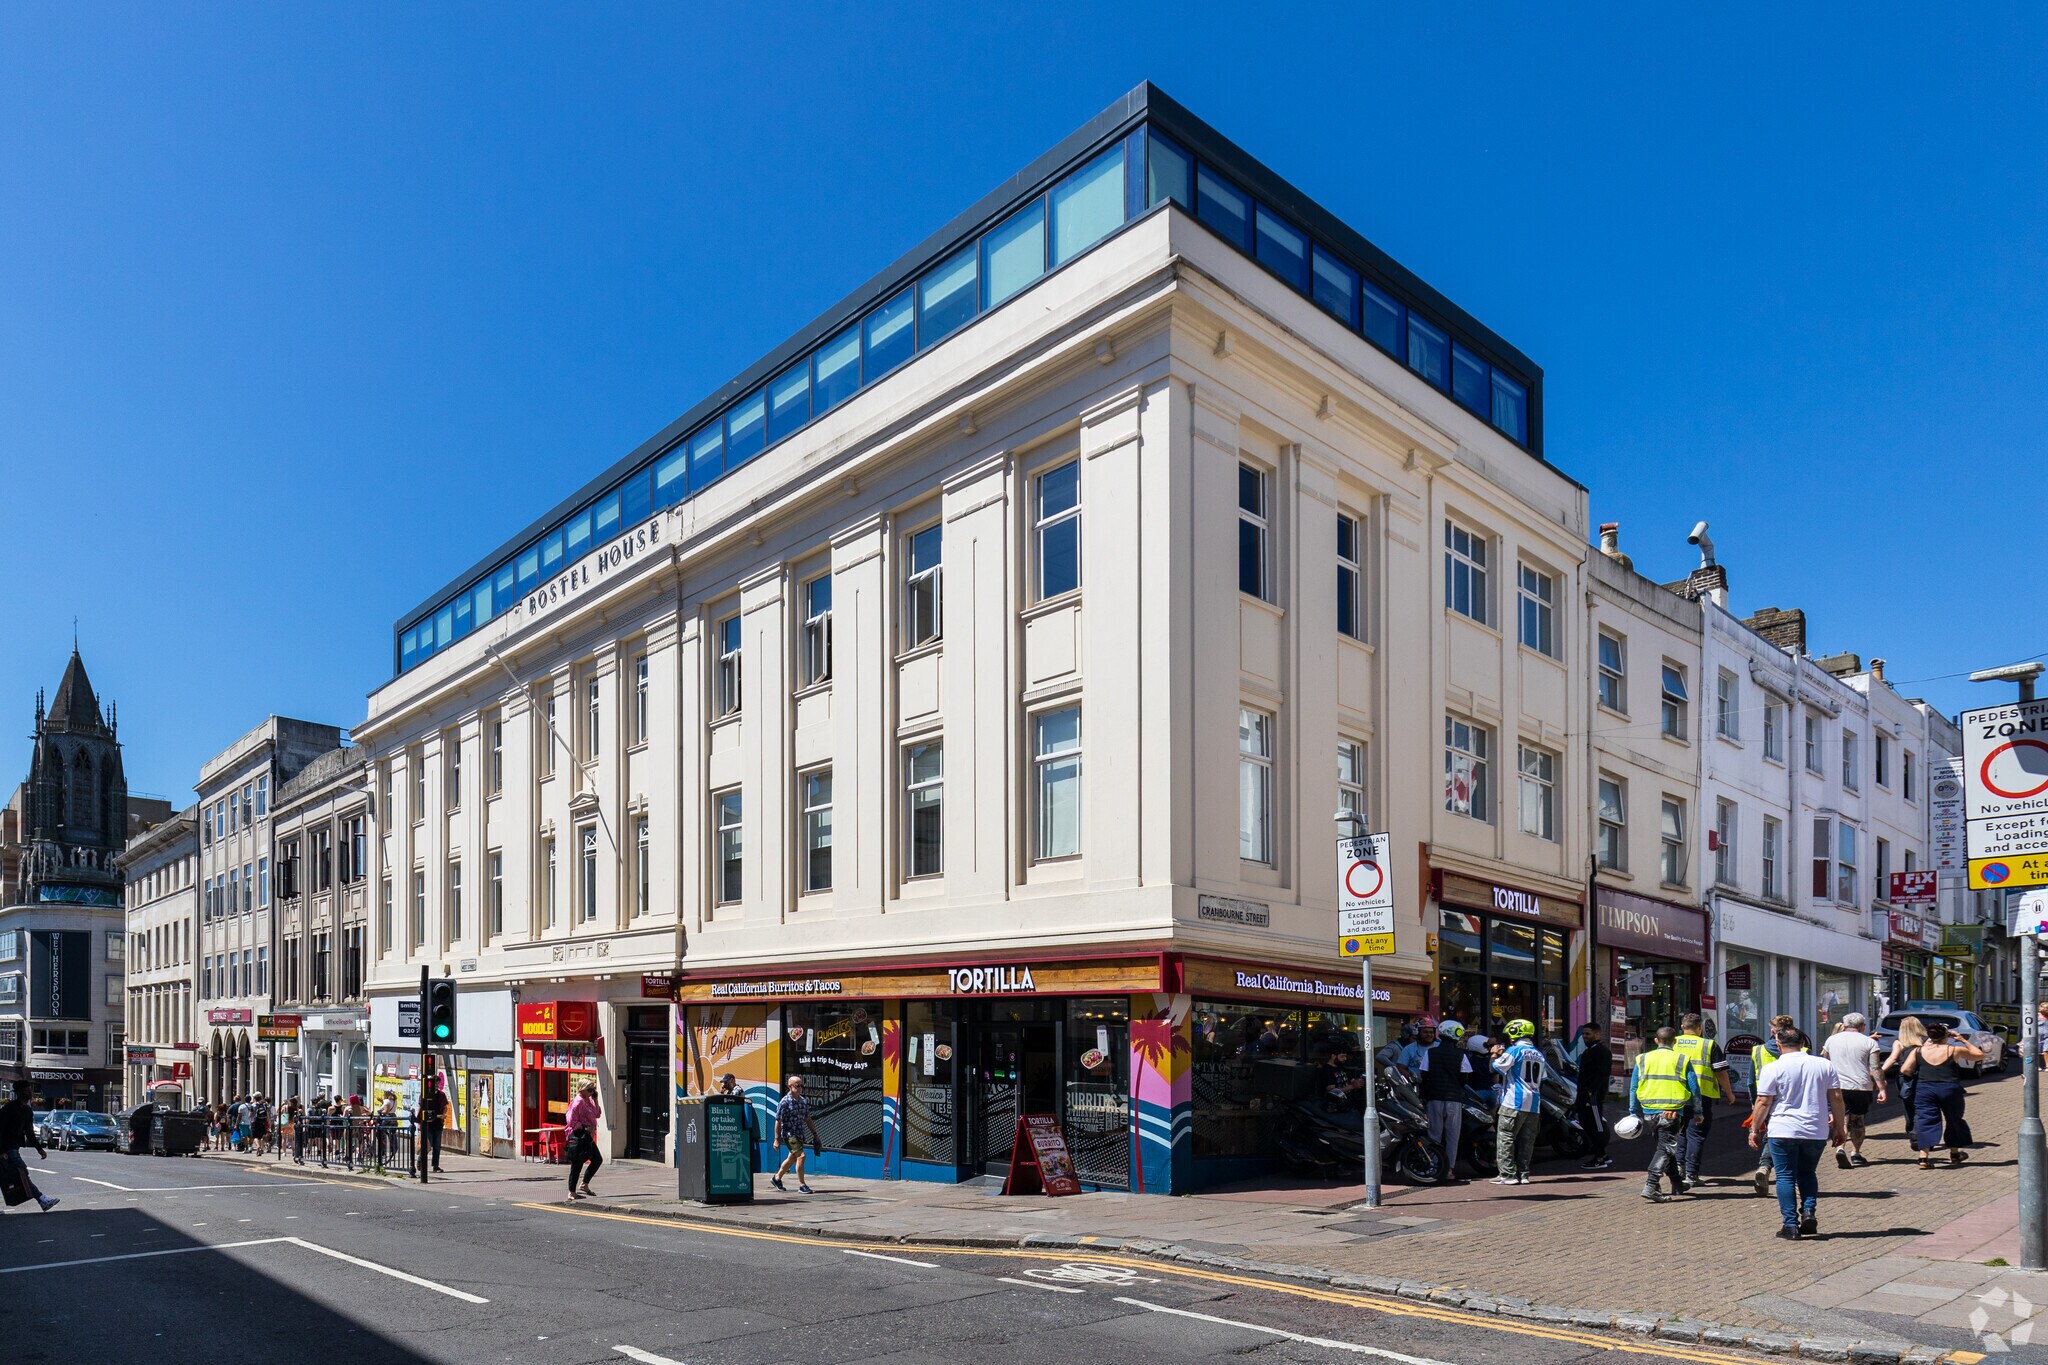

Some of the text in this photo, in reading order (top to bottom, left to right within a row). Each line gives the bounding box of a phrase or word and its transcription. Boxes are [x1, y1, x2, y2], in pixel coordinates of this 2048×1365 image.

[529, 519, 660, 616] BOSTEL HOUSE
[1969, 703, 2048, 724] PEDESTRI
[1981, 805, 2000, 814] No
[1986, 818, 2034, 831] Except
[1340, 836, 1386, 848] PEDESTRIAN
[1985, 843, 2009, 853] and
[1347, 846, 1380, 859] ZONE
[2022, 860, 2039, 869] At
[1357, 898, 1386, 906] vehicles
[1493, 887, 1540, 916] TORTILLA
[1202, 906, 1267, 923] CRANBOURNE STREET
[1599, 905, 1659, 936] TIMPSON
[1352, 918, 1380, 926] Loading
[1375, 937, 1388, 945] any
[52, 933, 60, 1016] WETHERSPOON
[948, 965, 1034, 991] TORTILLA
[645, 978, 670, 986] TORTILLA
[711, 979, 840, 995] Real California Burritos & Tacos
[1236, 972, 1390, 1001] Real California Burritos & acos
[697, 1012, 723, 1037] Hello
[816, 1018, 852, 1046] BURRITOS
[711, 1027, 758, 1060] Brighton
[1731, 1039, 1757, 1047] TIMPSO
[816, 1055, 827, 1063] trip
[828, 1057, 835, 1065] to
[834, 1059, 853, 1070] happy
[853, 1062, 868, 1070] days
[31, 1071, 84, 1080] WETHERSPOON
[1525, 1060, 1540, 1083] 10
[916, 1089, 943, 1099] Mexico
[1028, 1117, 1054, 1125] TORTILLA
[1036, 1139, 1061, 1148] BURRITO
